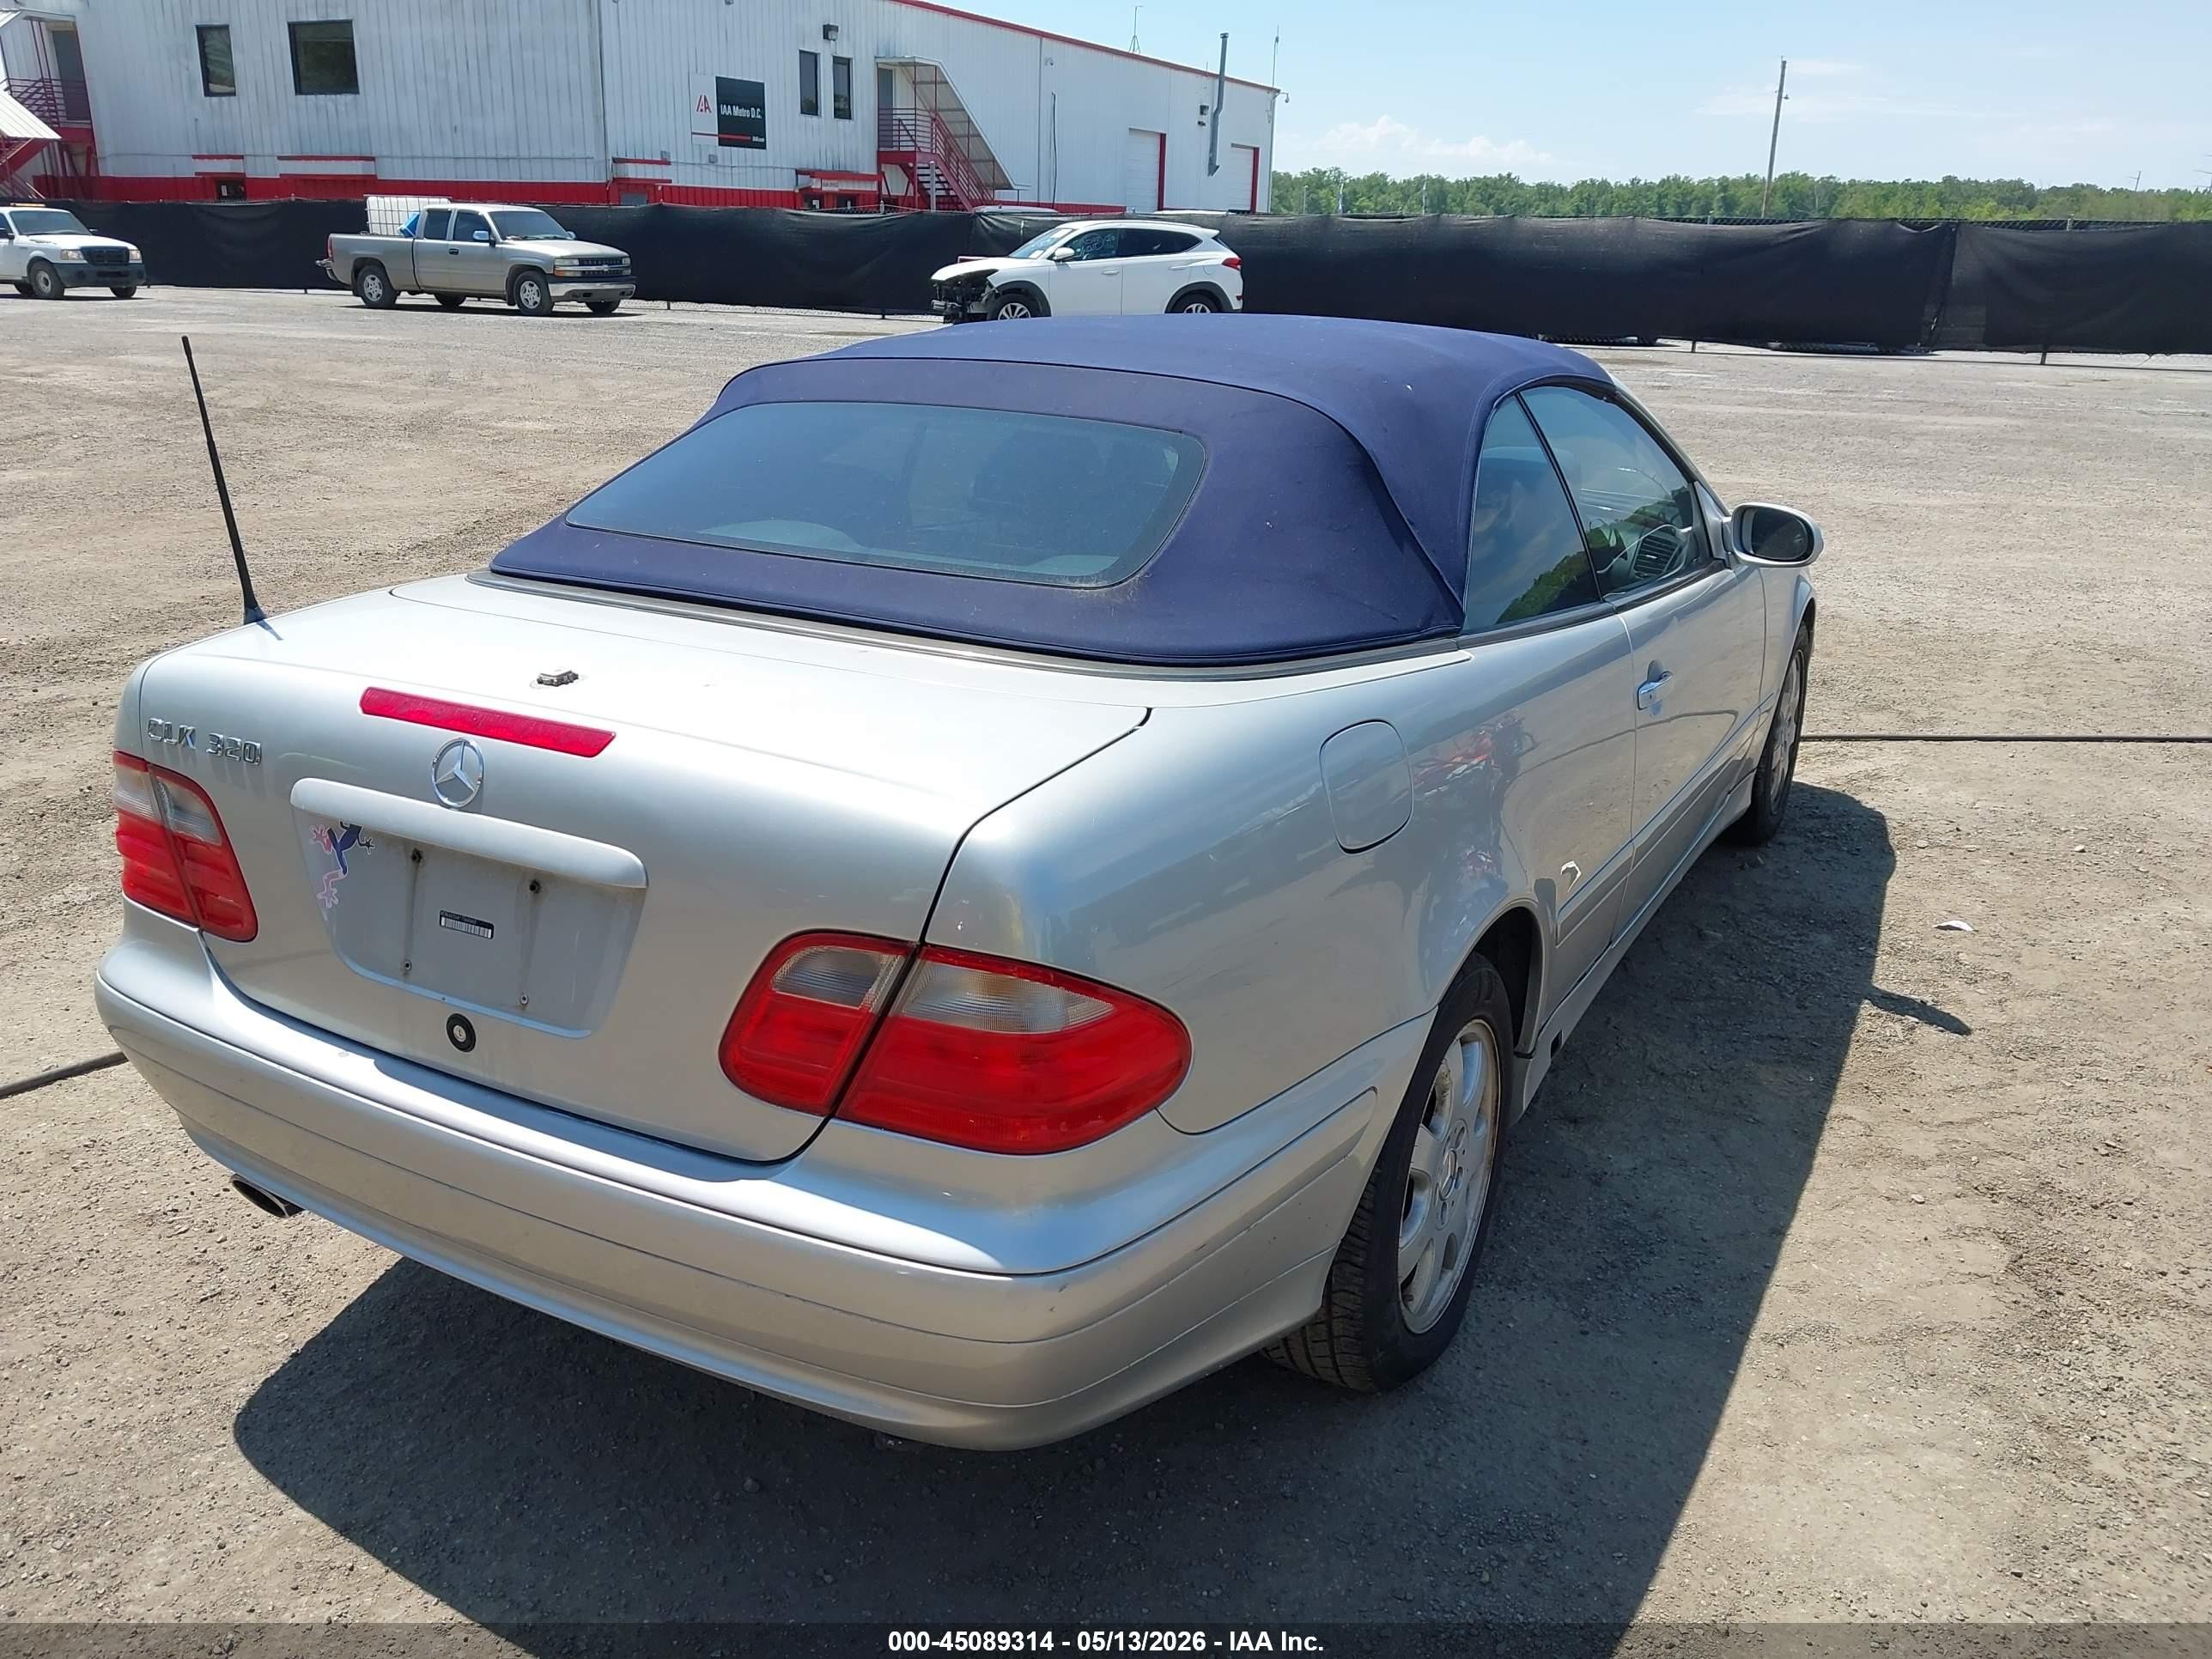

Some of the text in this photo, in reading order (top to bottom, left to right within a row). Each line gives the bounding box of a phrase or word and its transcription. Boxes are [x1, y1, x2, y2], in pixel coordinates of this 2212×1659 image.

[720, 103, 763, 118] IAA Metro D.C.
[148, 718, 262, 765] CLK 320
